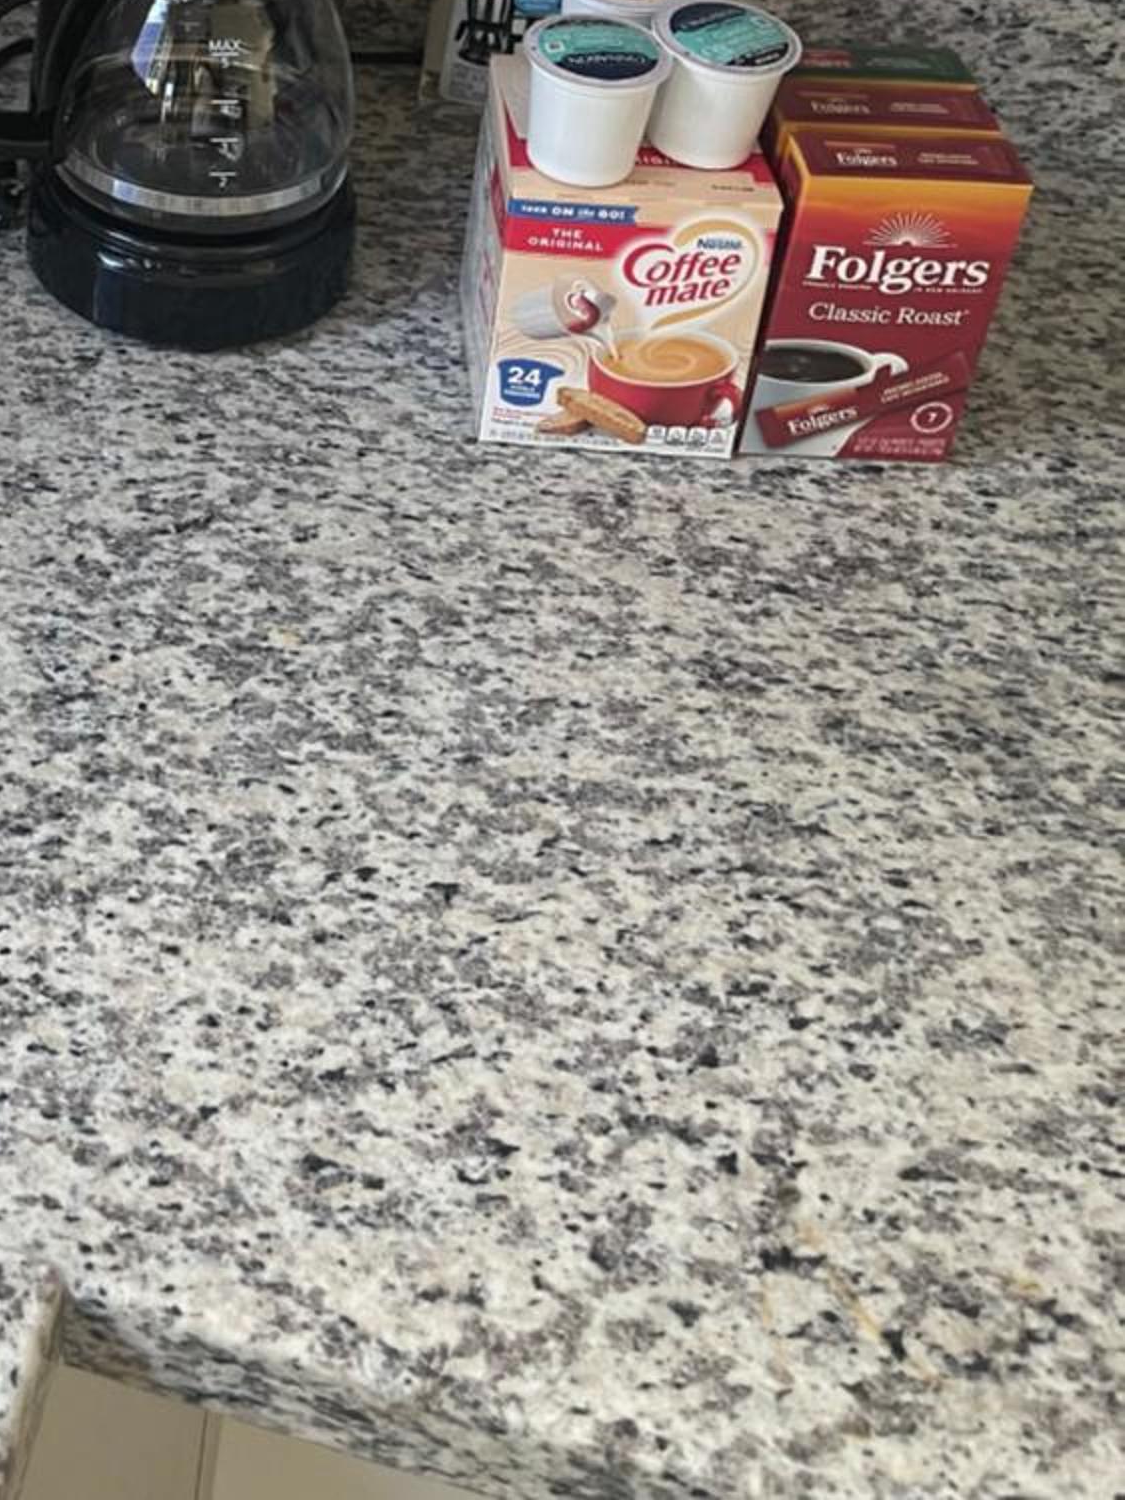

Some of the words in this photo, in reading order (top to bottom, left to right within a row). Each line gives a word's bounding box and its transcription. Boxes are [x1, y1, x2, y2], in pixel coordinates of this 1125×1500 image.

[208, 40, 241, 52] MAX
[836, 151, 898, 169] Folgers
[551, 205, 574, 217] ON
[552, 227, 583, 239] THE
[527, 235, 604, 253] ORIGINAL
[622, 242, 742, 289] Coffee
[805, 244, 991, 295] Folgers
[644, 273, 732, 307] mate
[808, 302, 892, 326] Classic
[896, 305, 963, 327] Roast
[507, 365, 542, 386] 24
[786, 405, 860, 436] Folgers
